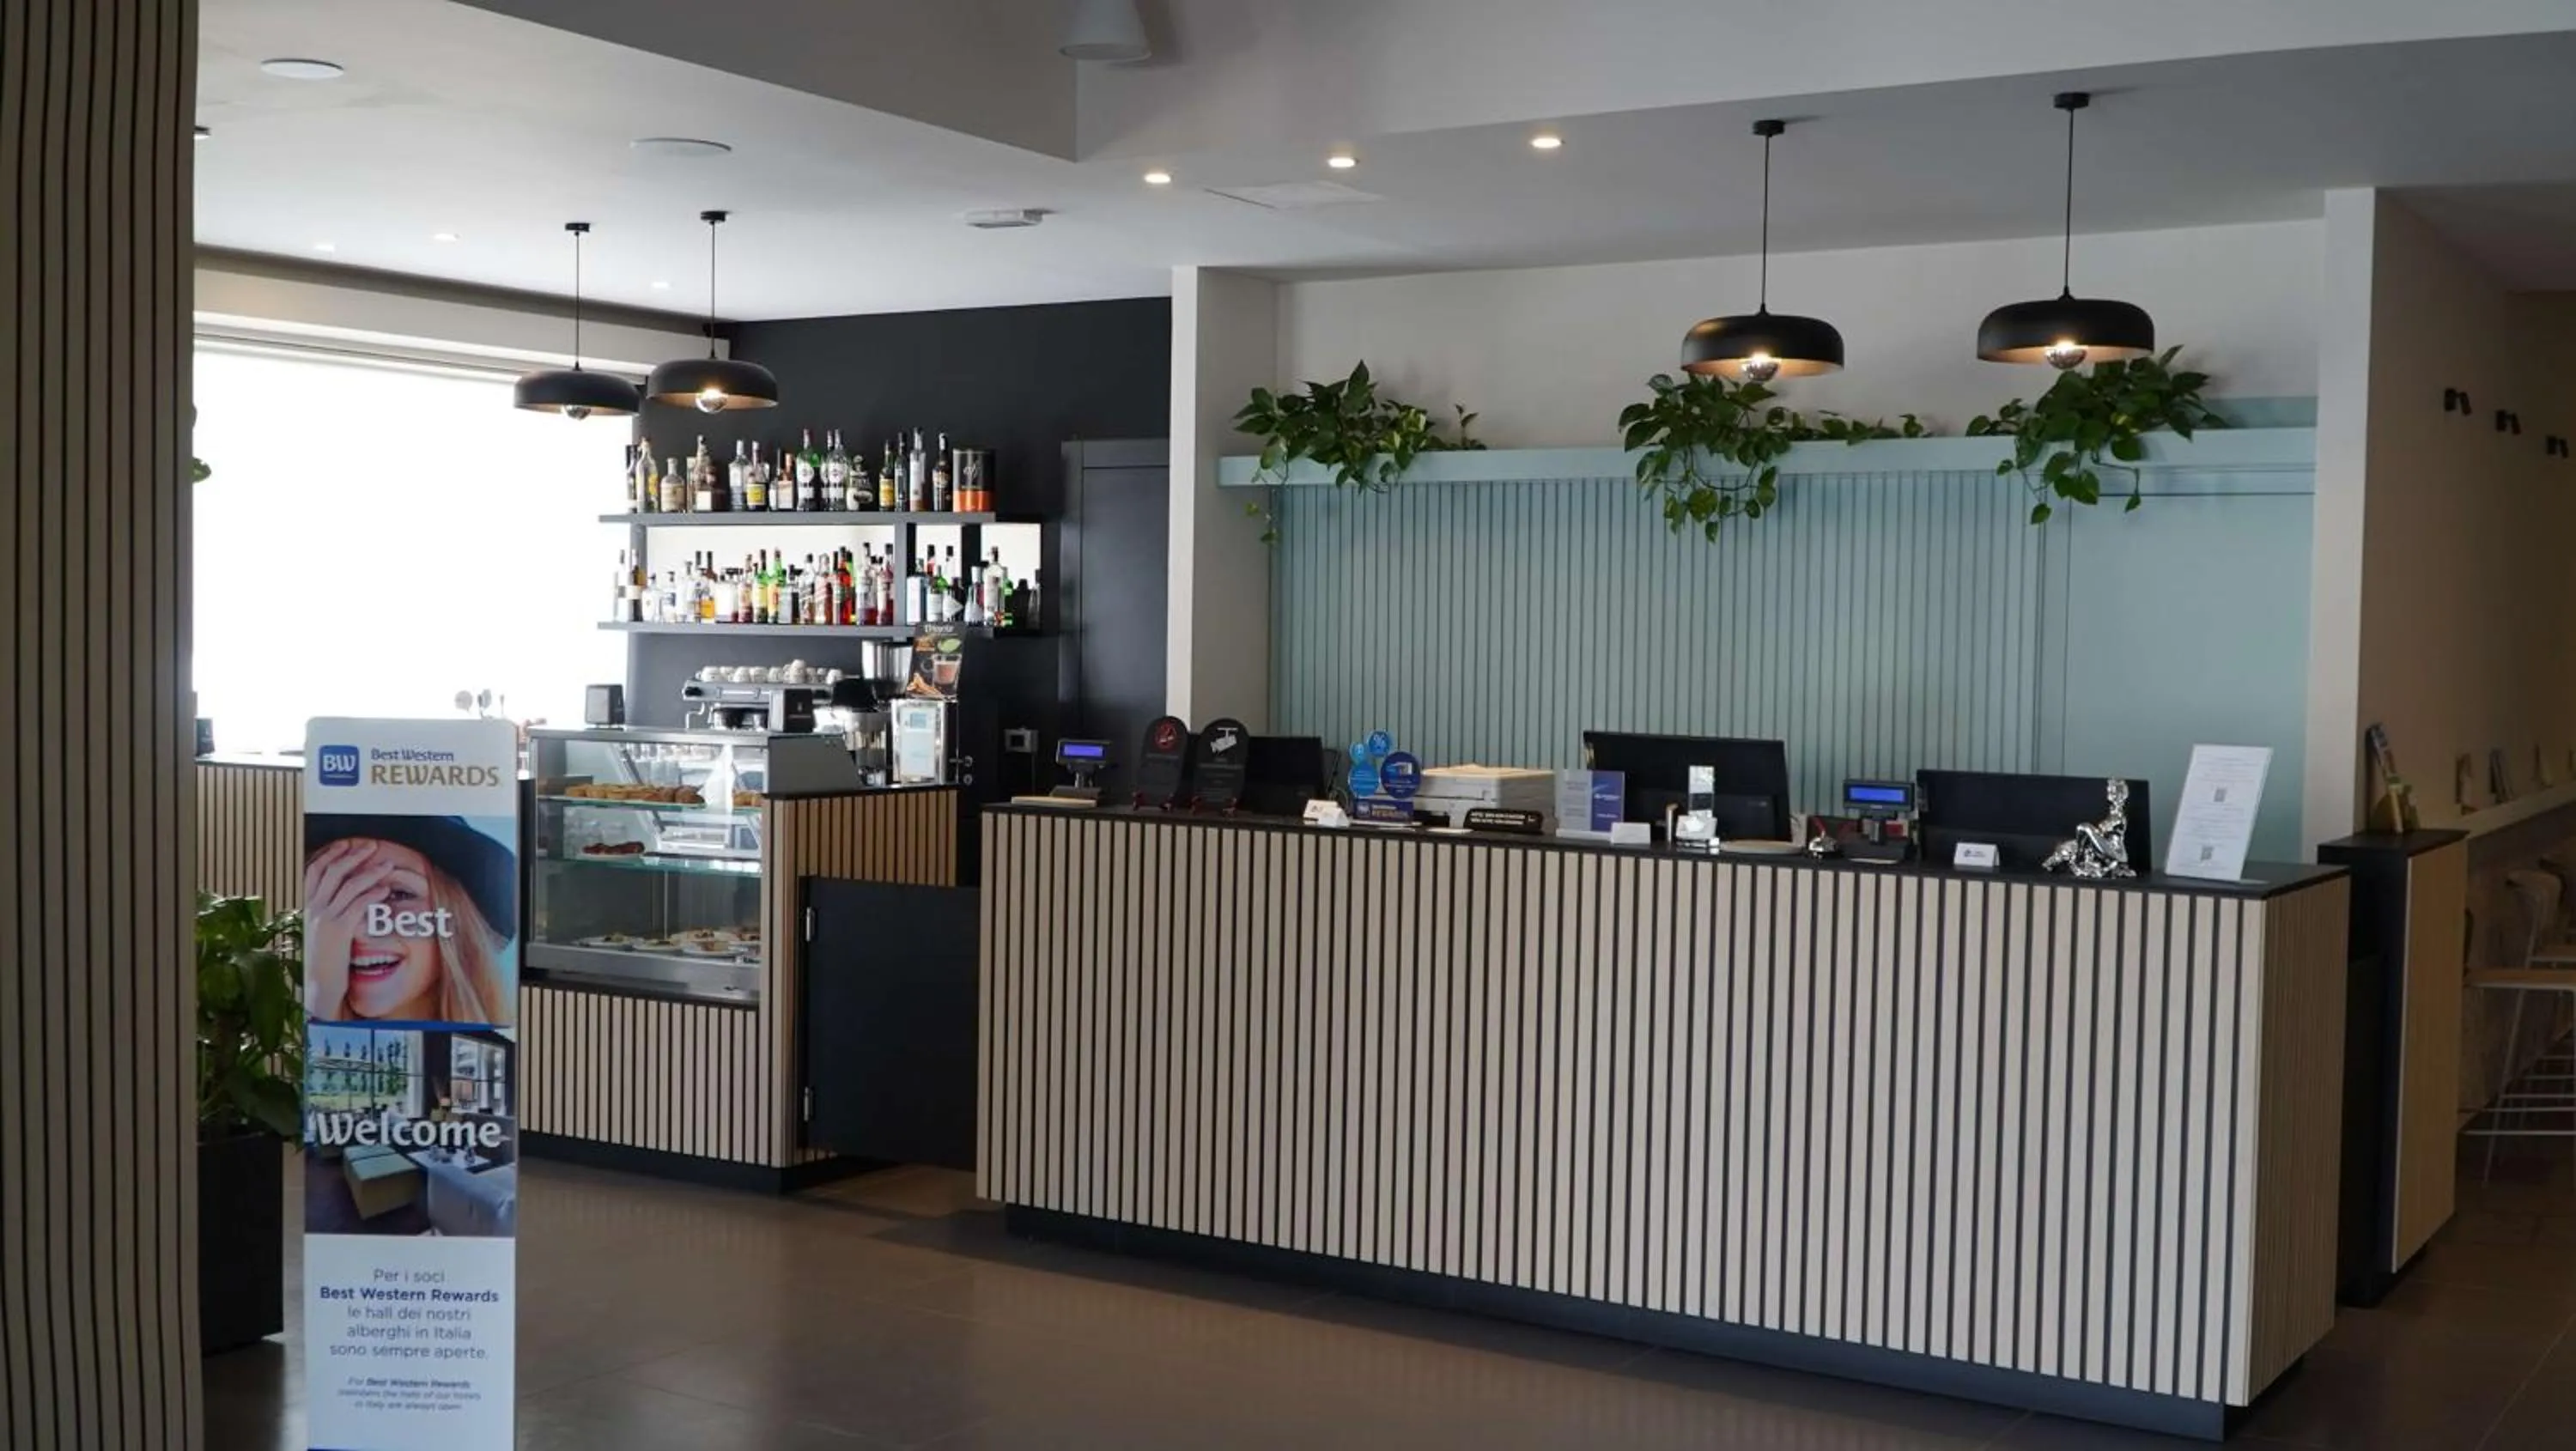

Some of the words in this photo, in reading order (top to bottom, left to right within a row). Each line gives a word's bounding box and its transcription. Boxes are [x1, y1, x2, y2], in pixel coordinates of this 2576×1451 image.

[371, 748, 398, 761] Best
[401, 749, 454, 762] Western
[323, 755, 356, 772] BW
[371, 764, 501, 787] REWARDS
[368, 903, 454, 938] Best
[318, 1111, 502, 1148] Welcome
[374, 1268, 398, 1283] Per
[414, 1269, 446, 1283] soci
[320, 1286, 355, 1300] Best
[361, 1287, 426, 1302] Western
[432, 1289, 500, 1302] Rewards
[347, 1305, 361, 1318] le
[366, 1306, 392, 1320] hall
[398, 1307, 421, 1320] dei
[426, 1308, 471, 1321] nostri
[346, 1324, 411, 1340] alberghi
[416, 1326, 428, 1339] in
[434, 1327, 471, 1340] Italia
[330, 1345, 367, 1356] sono
[372, 1345, 429, 1359] sempre
